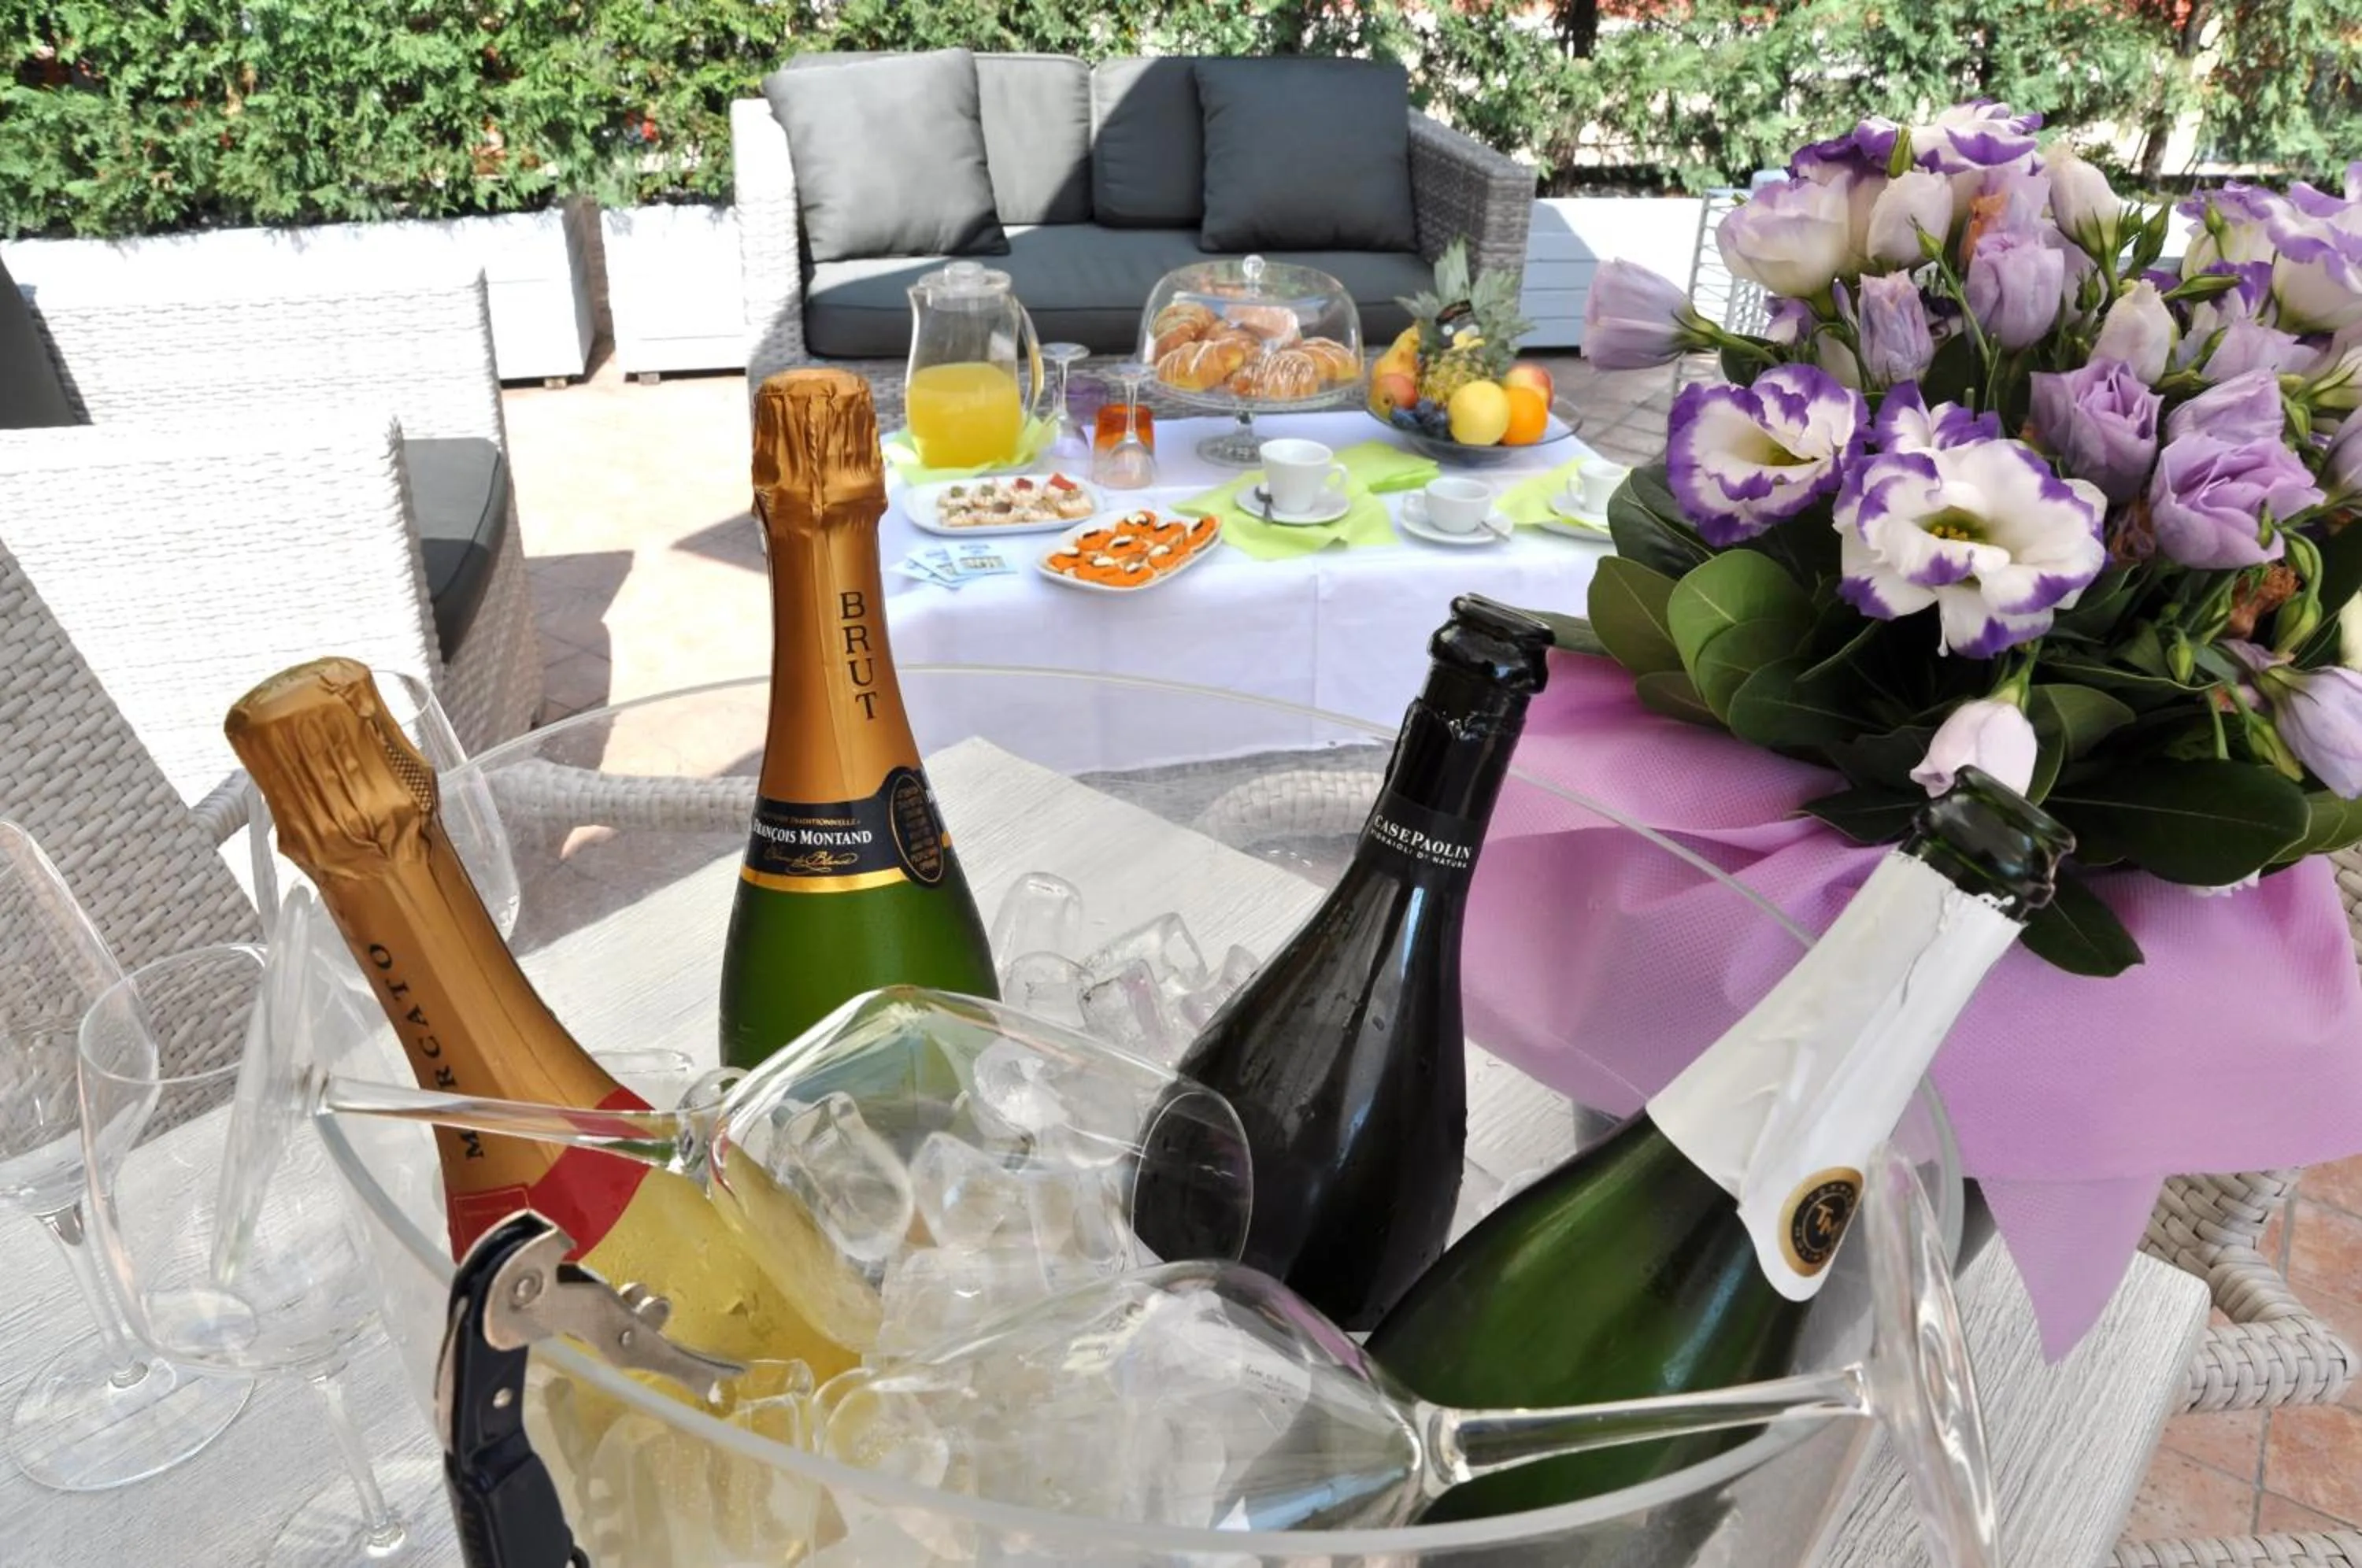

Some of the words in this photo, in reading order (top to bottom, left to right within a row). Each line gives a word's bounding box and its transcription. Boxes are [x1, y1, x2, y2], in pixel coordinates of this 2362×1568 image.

[840, 591, 878, 720] BRUT
[799, 829, 872, 845] MONTAND
[369, 945, 483, 1159] MRCATO
